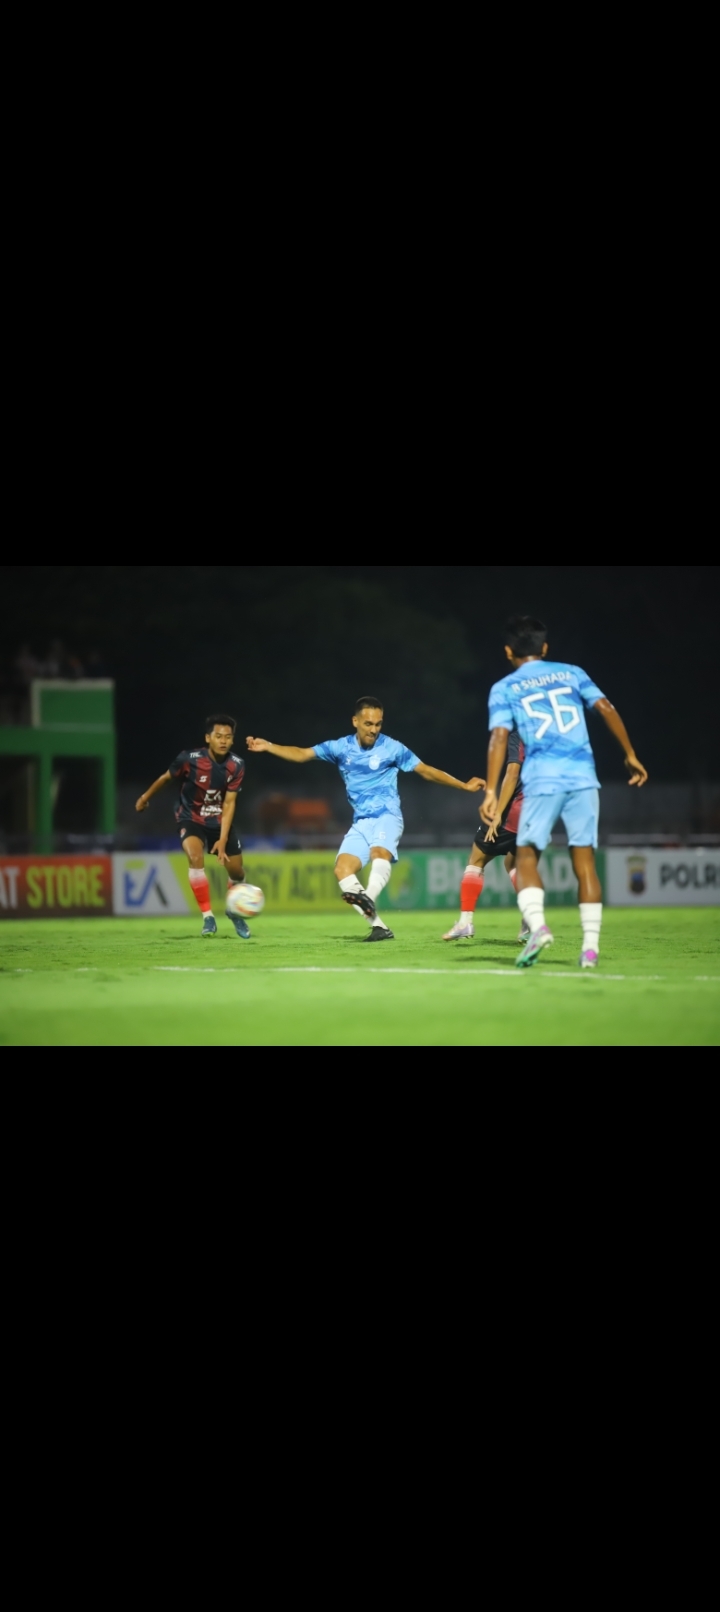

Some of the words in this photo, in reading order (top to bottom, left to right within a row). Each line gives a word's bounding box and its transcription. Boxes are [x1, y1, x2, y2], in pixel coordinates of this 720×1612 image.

[520, 671, 573, 691] SYUHADA
[520, 686, 580, 740] 56
[25, 864, 104, 909] STORE
